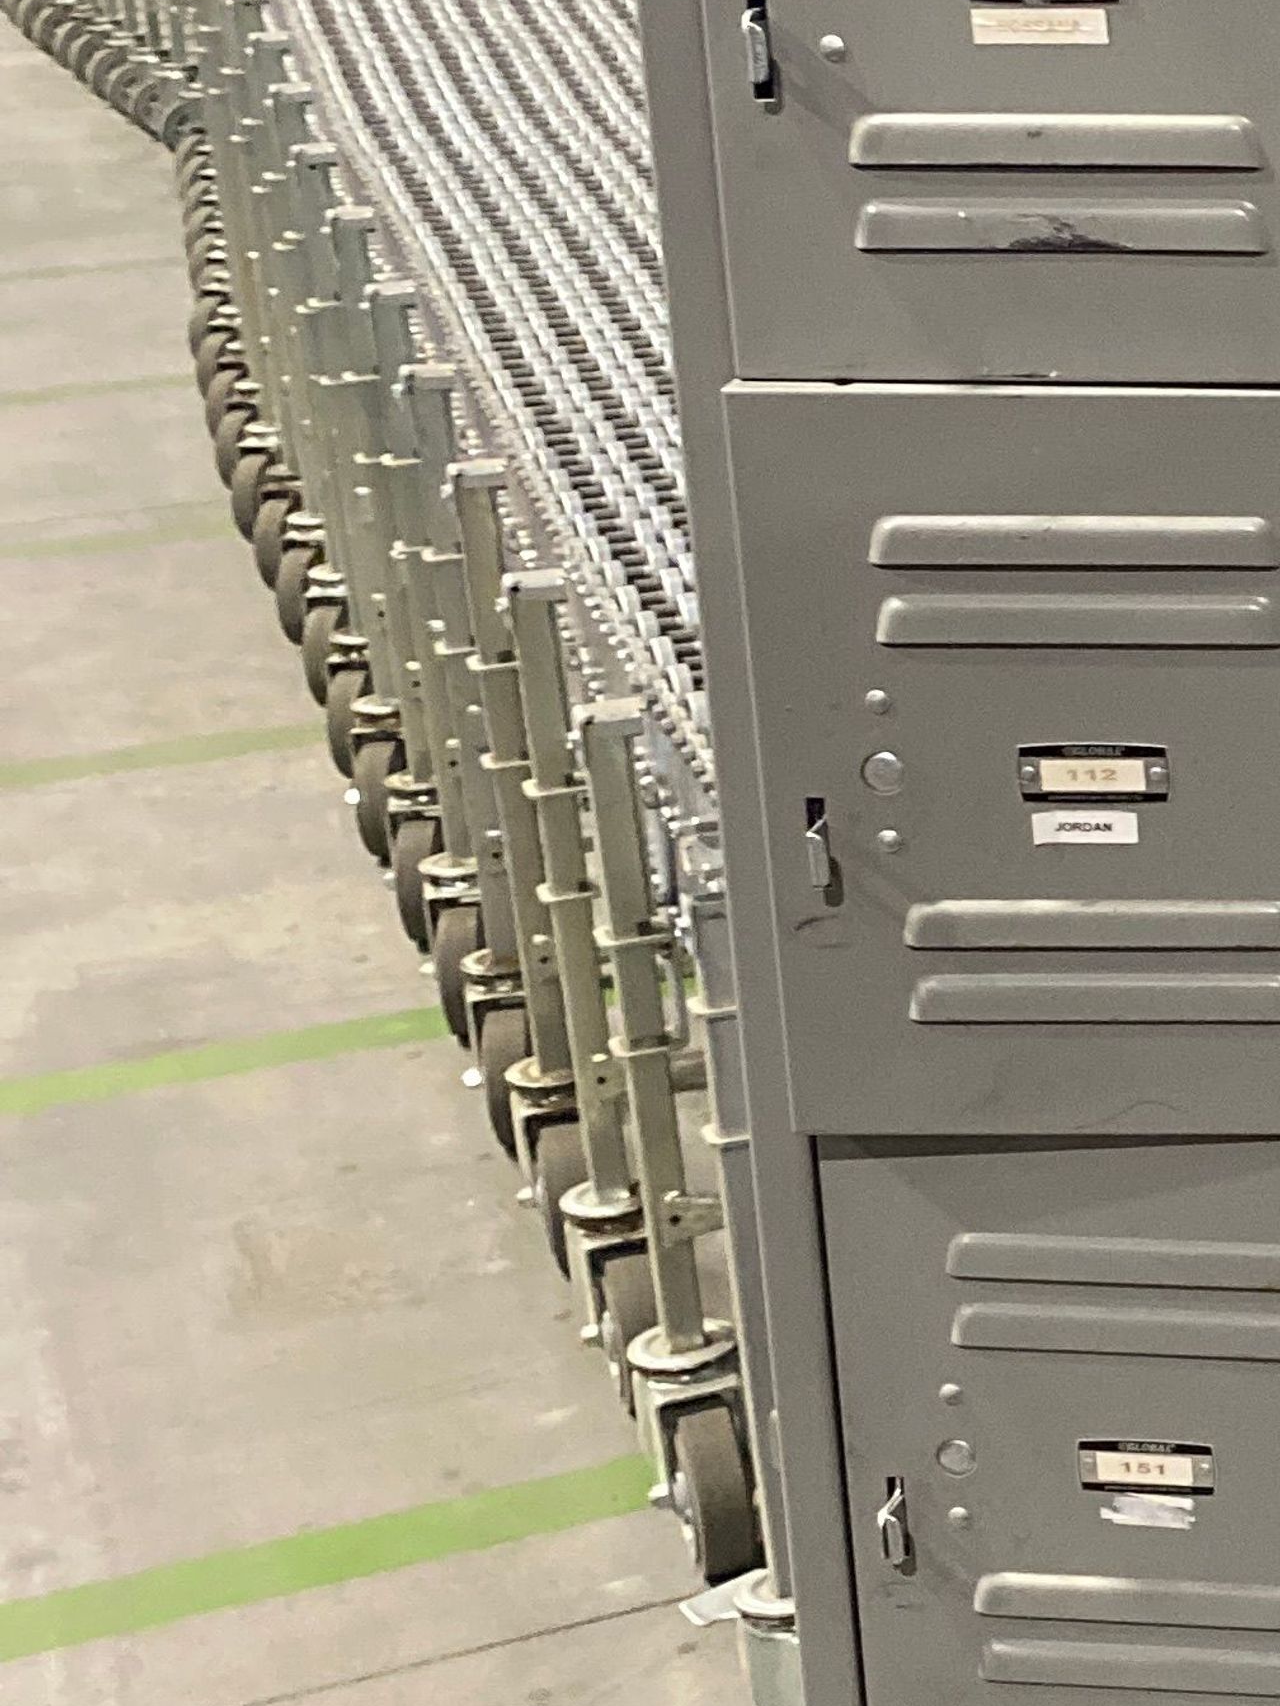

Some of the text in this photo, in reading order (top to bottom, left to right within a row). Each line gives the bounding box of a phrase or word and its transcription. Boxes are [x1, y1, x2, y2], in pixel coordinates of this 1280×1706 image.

[1066, 768, 1119, 782] 112
[1055, 822, 1113, 833] JORDAN
[1120, 1461, 1165, 1475] 151
